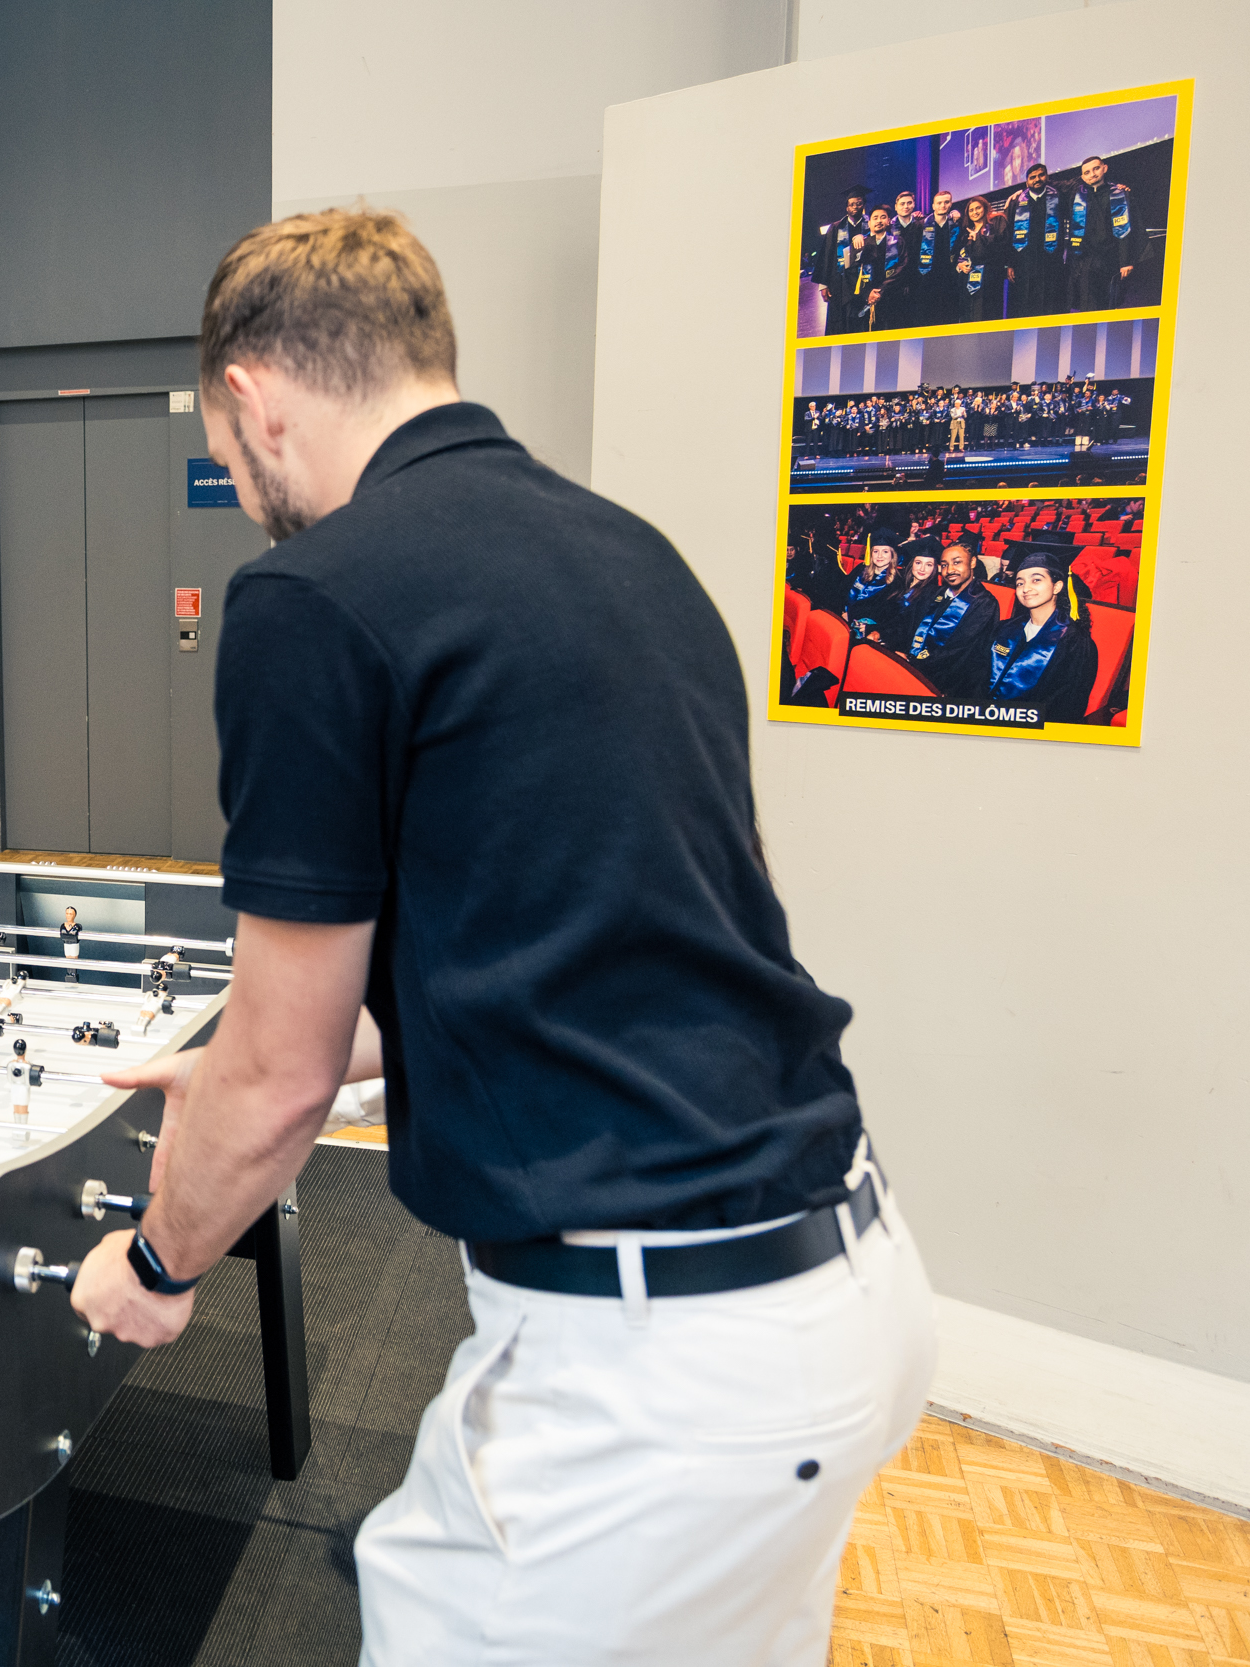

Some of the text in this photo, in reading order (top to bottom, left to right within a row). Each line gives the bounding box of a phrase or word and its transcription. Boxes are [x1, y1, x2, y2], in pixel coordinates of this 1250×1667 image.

[194, 477, 218, 486] ACCÈS
[846, 698, 1039, 723] REMISE DES DIPLÔMES
